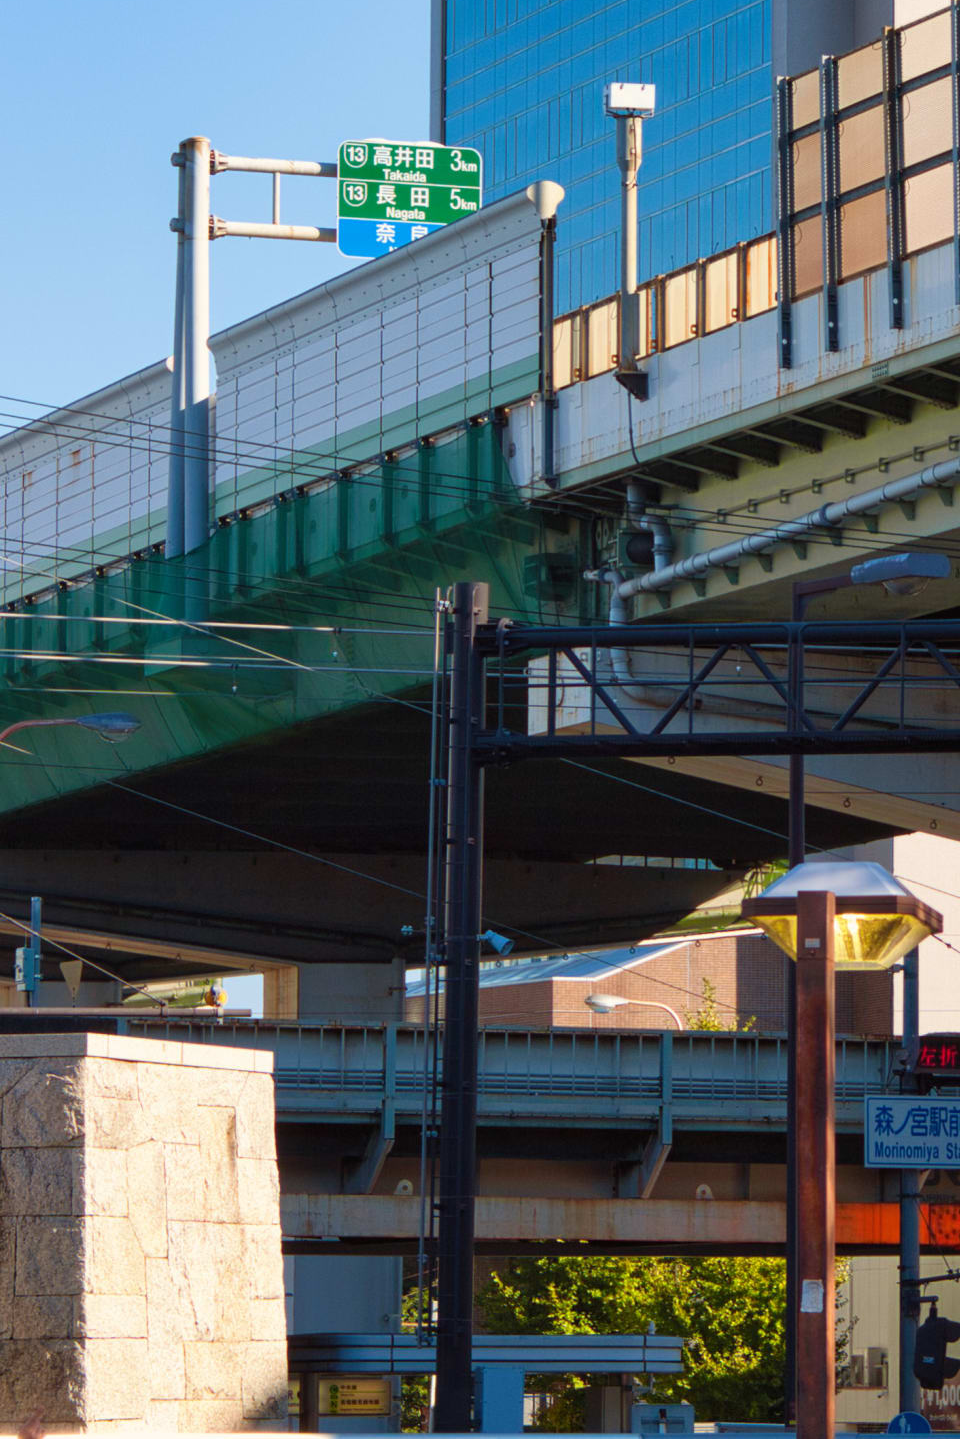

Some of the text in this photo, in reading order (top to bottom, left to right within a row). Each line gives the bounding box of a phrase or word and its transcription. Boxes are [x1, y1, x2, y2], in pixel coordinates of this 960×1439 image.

[347, 145, 477, 173] 13 高井田 3km
[382, 168, 427, 183] Takaida
[347, 185, 364, 202] 13
[450, 189, 477, 211] 5km
[386, 206, 426, 221] Nagata
[874, 1141, 940, 1162] Morinomiya
